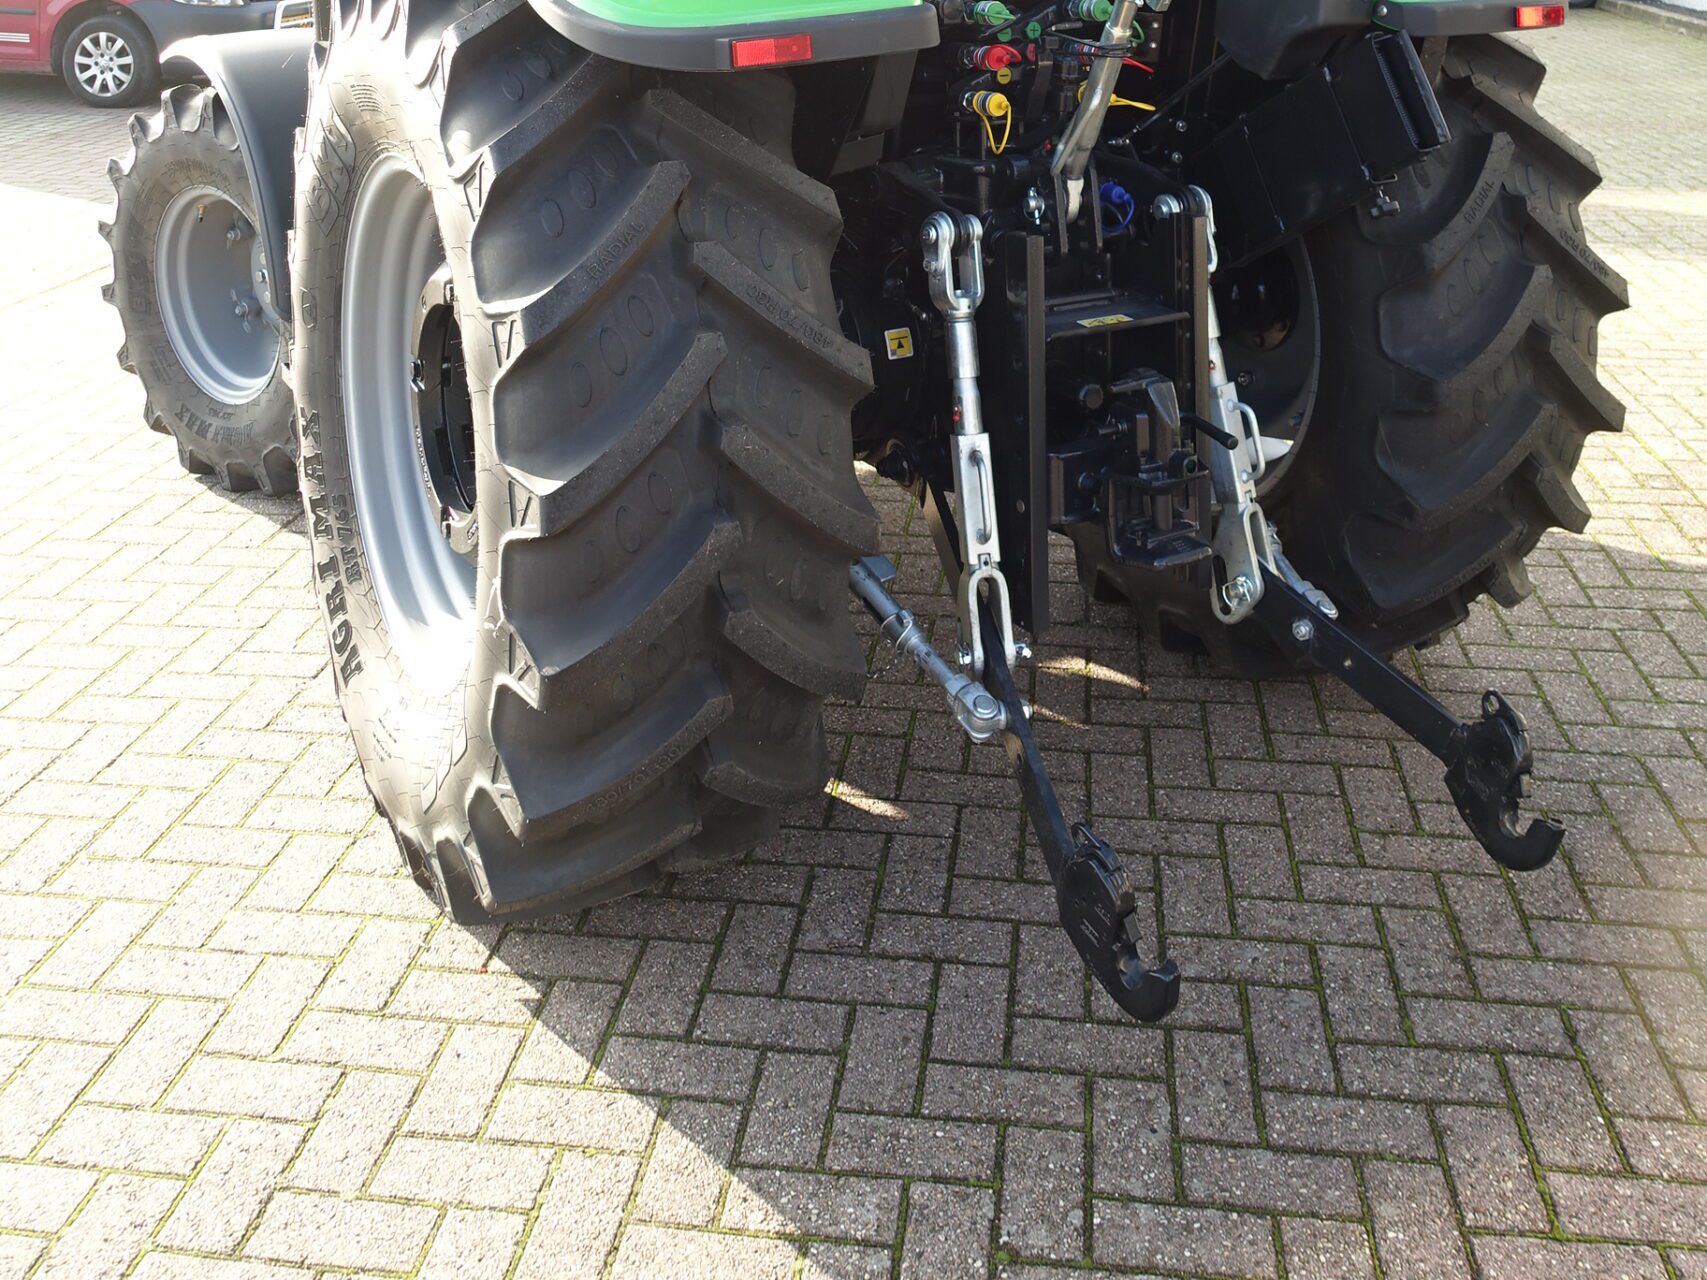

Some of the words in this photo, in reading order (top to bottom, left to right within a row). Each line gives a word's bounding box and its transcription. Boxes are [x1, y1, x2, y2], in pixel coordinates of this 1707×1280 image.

[1463, 181, 1495, 224] RADIAL
[586, 220, 645, 279] RADIAL
[331, 493, 355, 541] 765
[340, 545, 362, 585] RT
